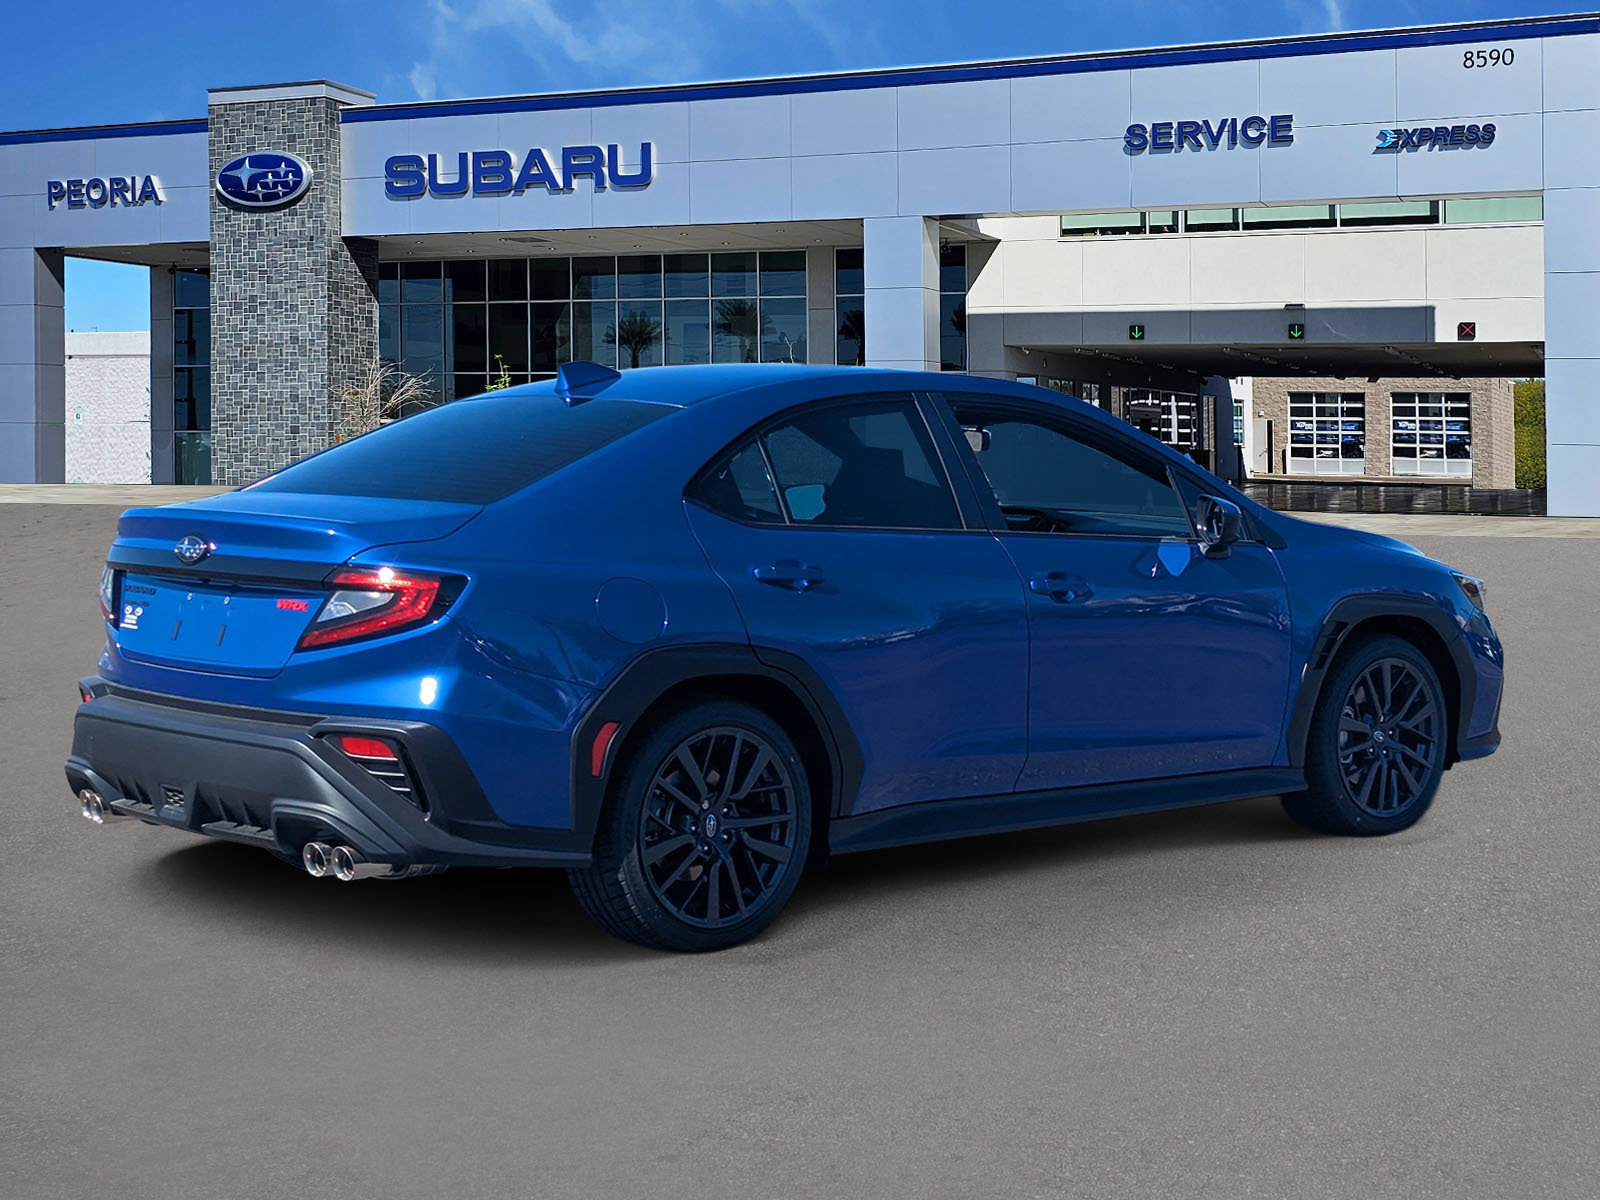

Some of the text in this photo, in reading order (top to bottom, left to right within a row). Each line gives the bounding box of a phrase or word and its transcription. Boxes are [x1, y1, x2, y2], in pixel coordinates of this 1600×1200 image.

[1463, 48, 1515, 69] 8590
[1125, 114, 1293, 151] SERVICE
[1376, 123, 1495, 150] EXPRESS
[384, 141, 652, 198] SUBARU
[47, 174, 161, 208] PEORIA
[276, 599, 309, 612] WRX
